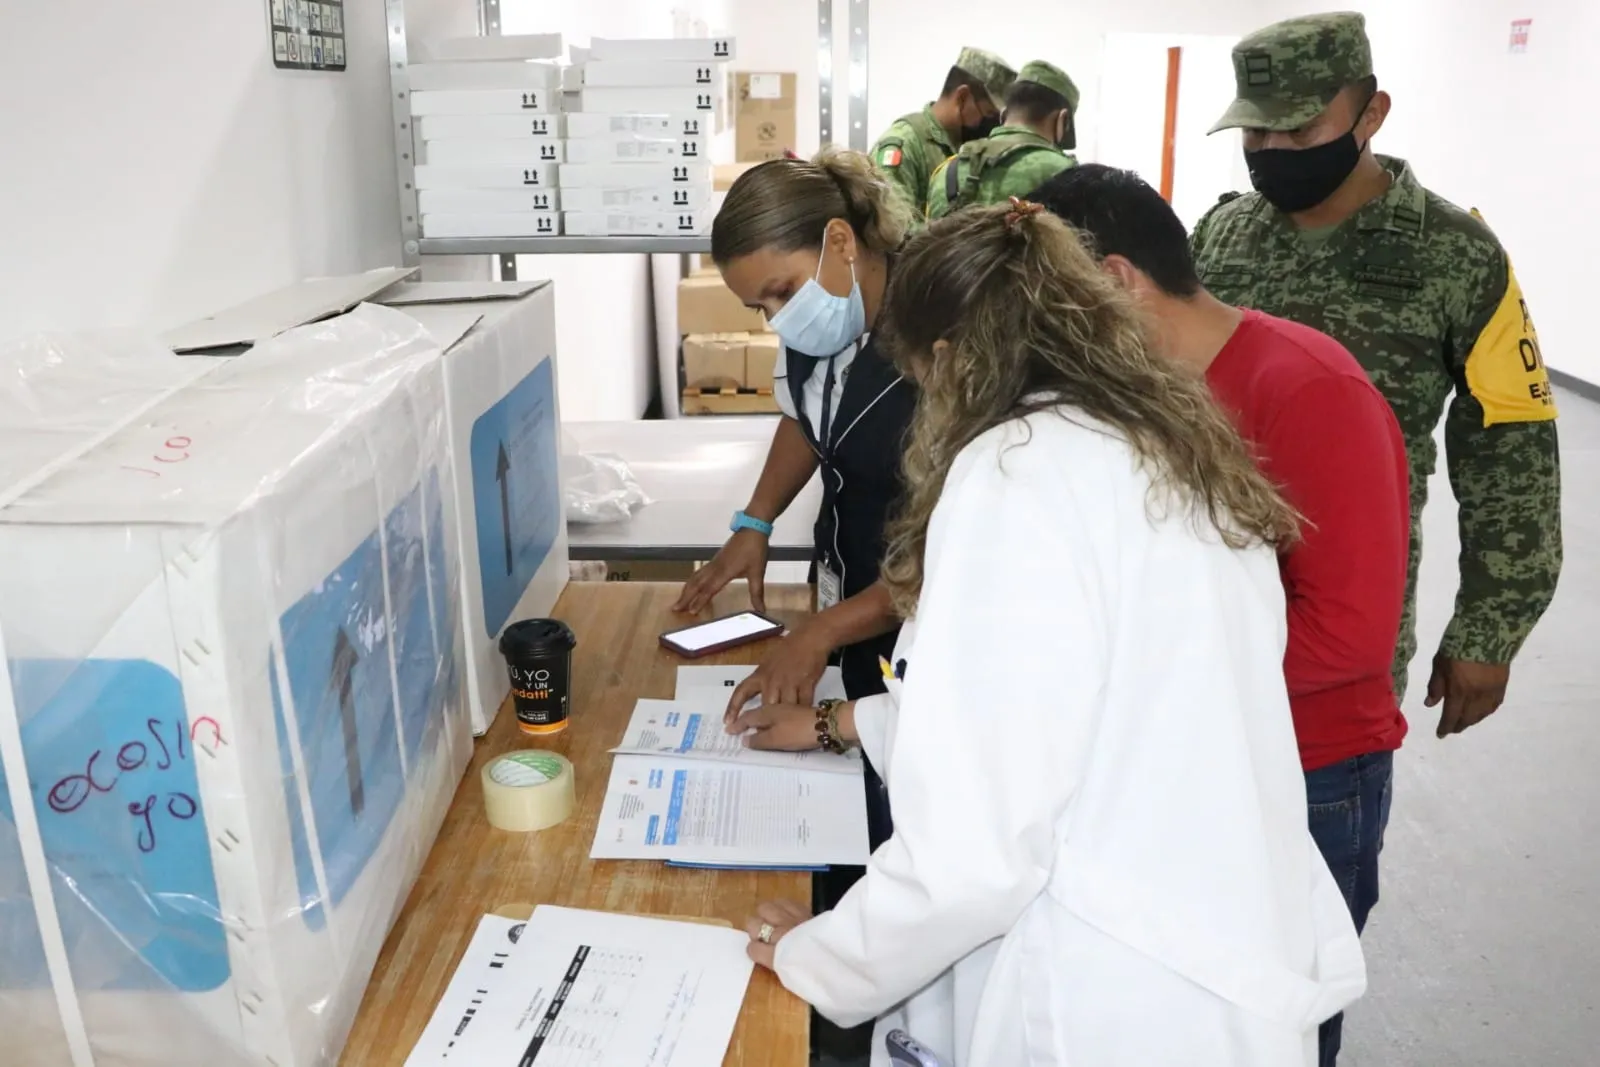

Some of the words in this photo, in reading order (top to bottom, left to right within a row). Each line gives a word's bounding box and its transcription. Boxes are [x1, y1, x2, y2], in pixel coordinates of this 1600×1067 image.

[524, 669, 550, 681] YO
[534, 682, 548, 690] UN
[511, 688, 549, 699] ndatti
